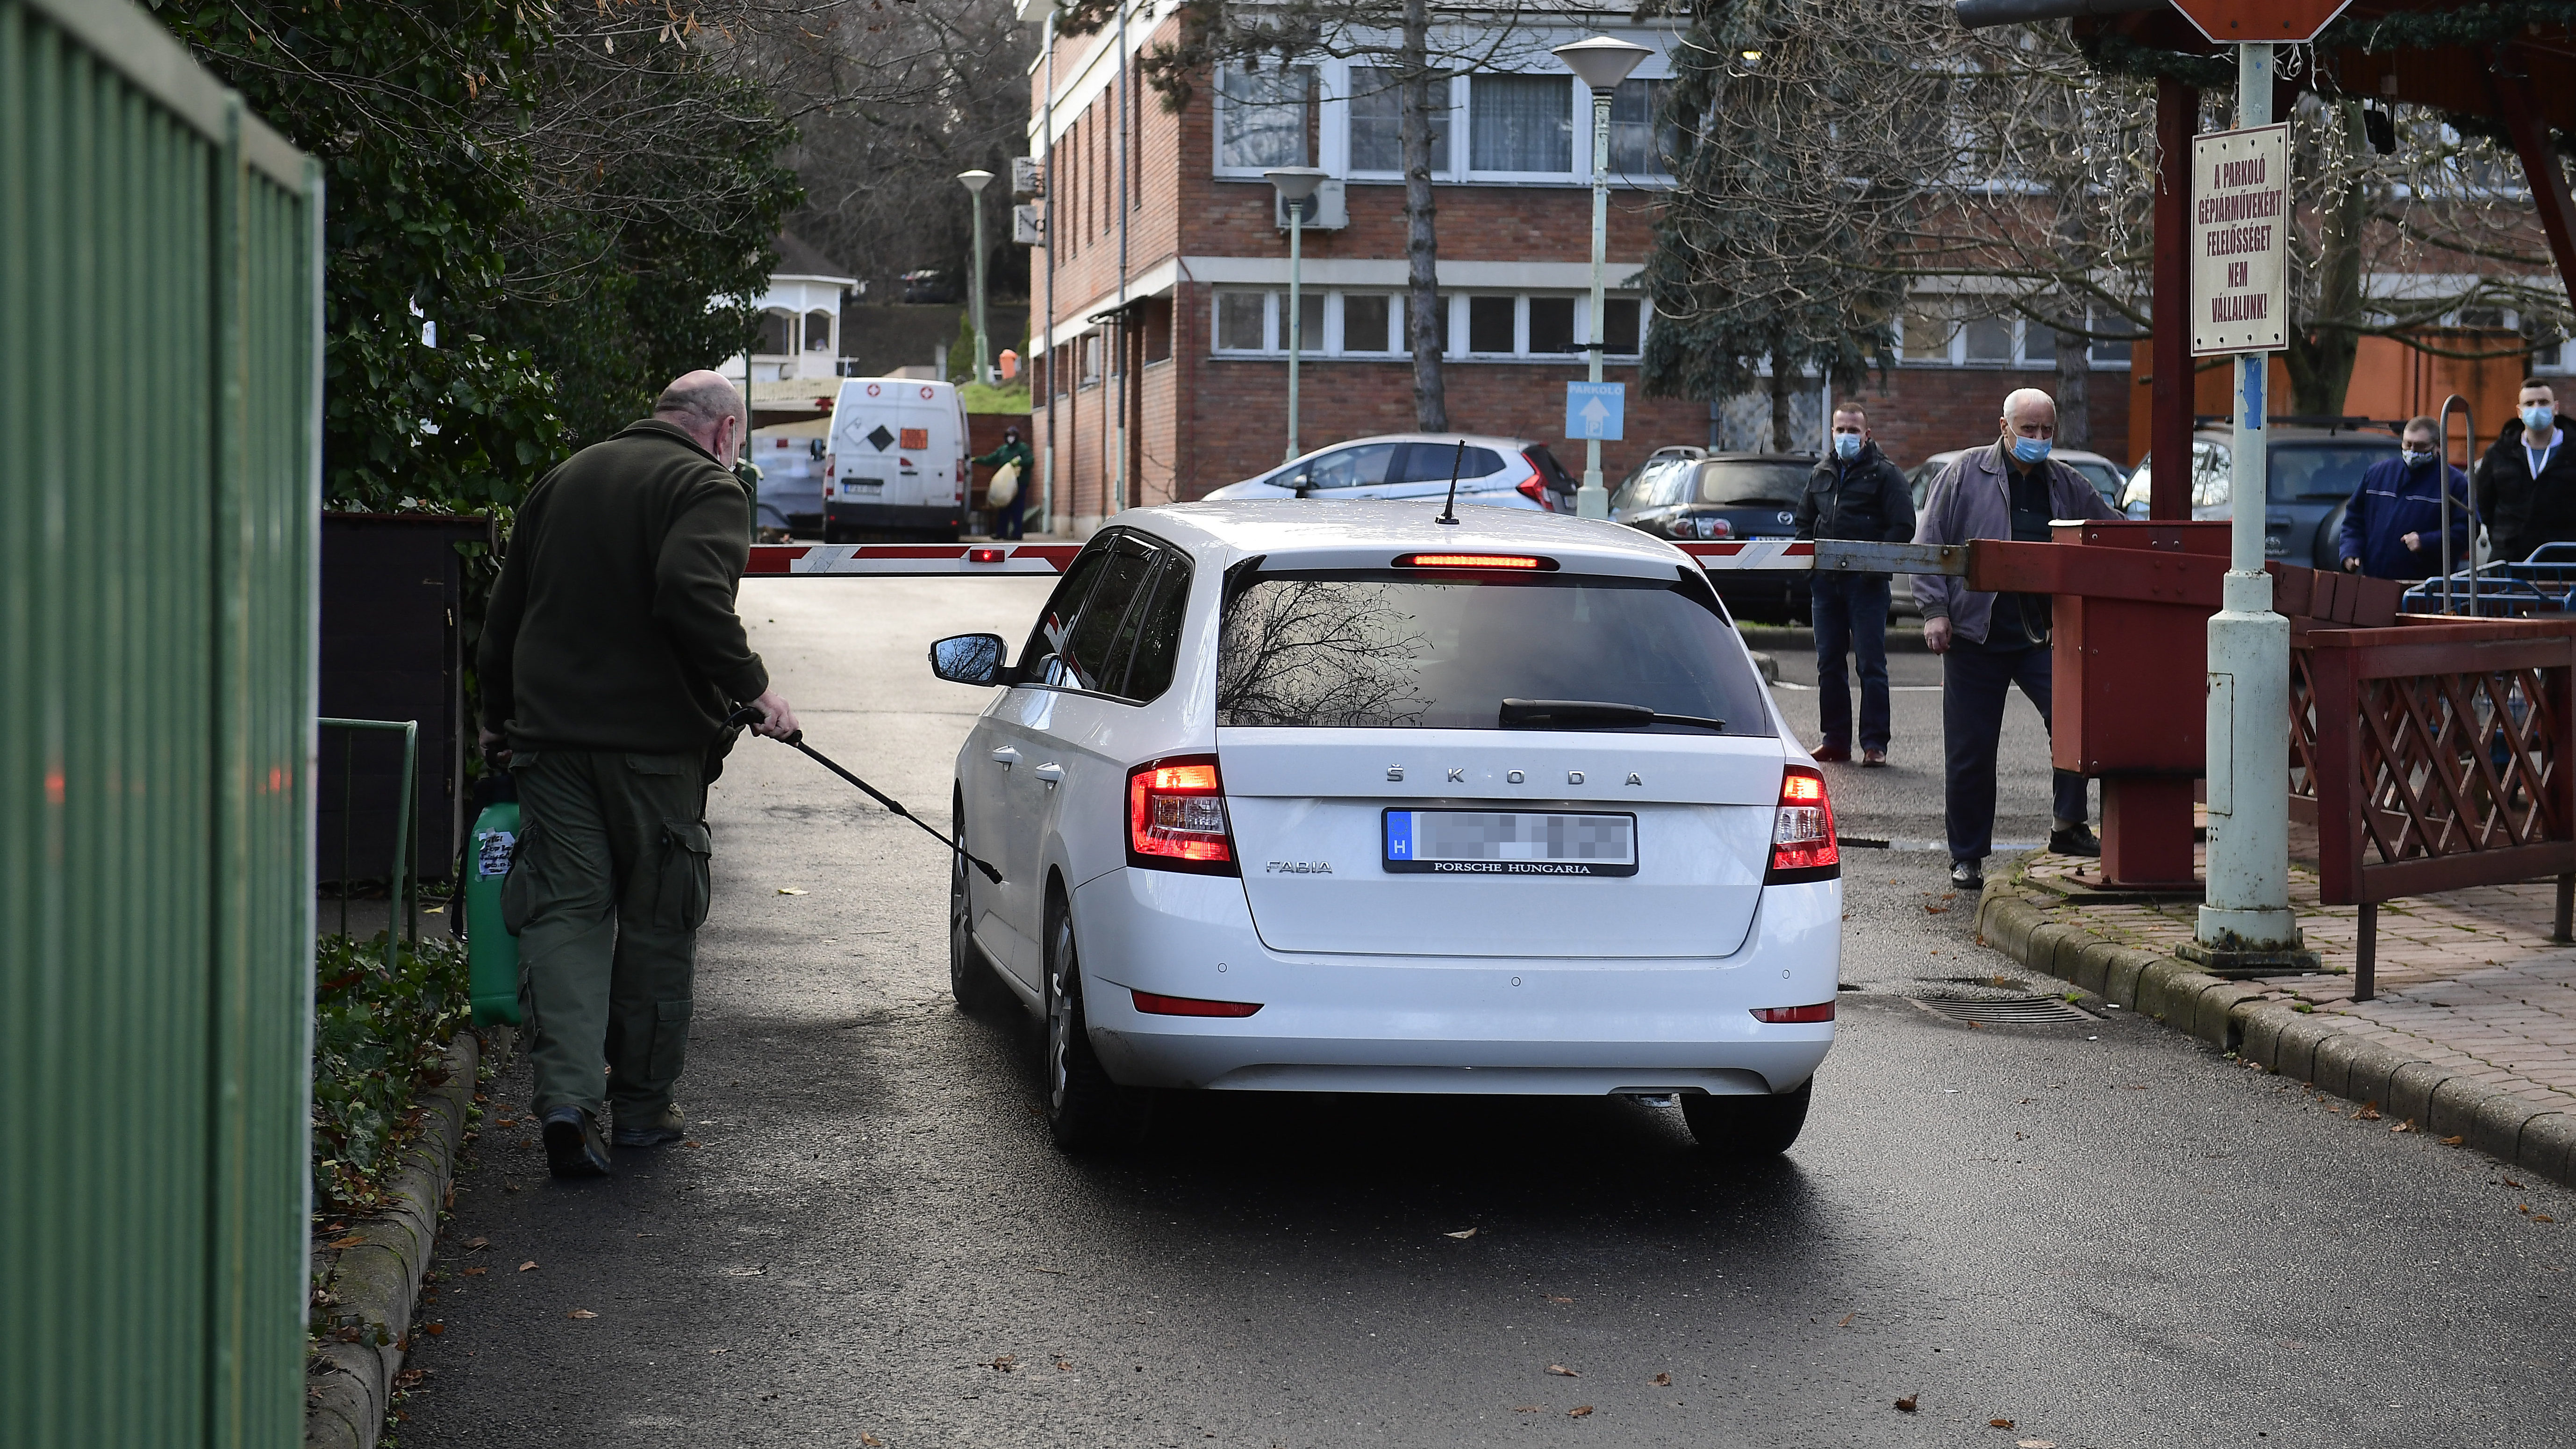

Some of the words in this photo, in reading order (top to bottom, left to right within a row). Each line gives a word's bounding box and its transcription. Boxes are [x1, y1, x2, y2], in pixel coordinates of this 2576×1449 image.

[2214, 164, 2220, 189] A
[2223, 152, 2265, 188] PARKOLÓ
[2198, 186, 2282, 225] GÉPJÁRMŰVEKÉRT
[2206, 222, 2272, 257] FELELŐSSÉGET
[2228, 261, 2248, 288] NEM
[2211, 292, 2268, 323] VÁLLALUNK!
[1589, 422, 1600, 434] P
[1387, 763, 1643, 786] ŠKODA
[1394, 840, 1406, 854] H
[1266, 860, 1333, 874] FABIA
[1434, 862, 1503, 872] PORSCHE
[1508, 864, 1591, 874] HUNGARIA
